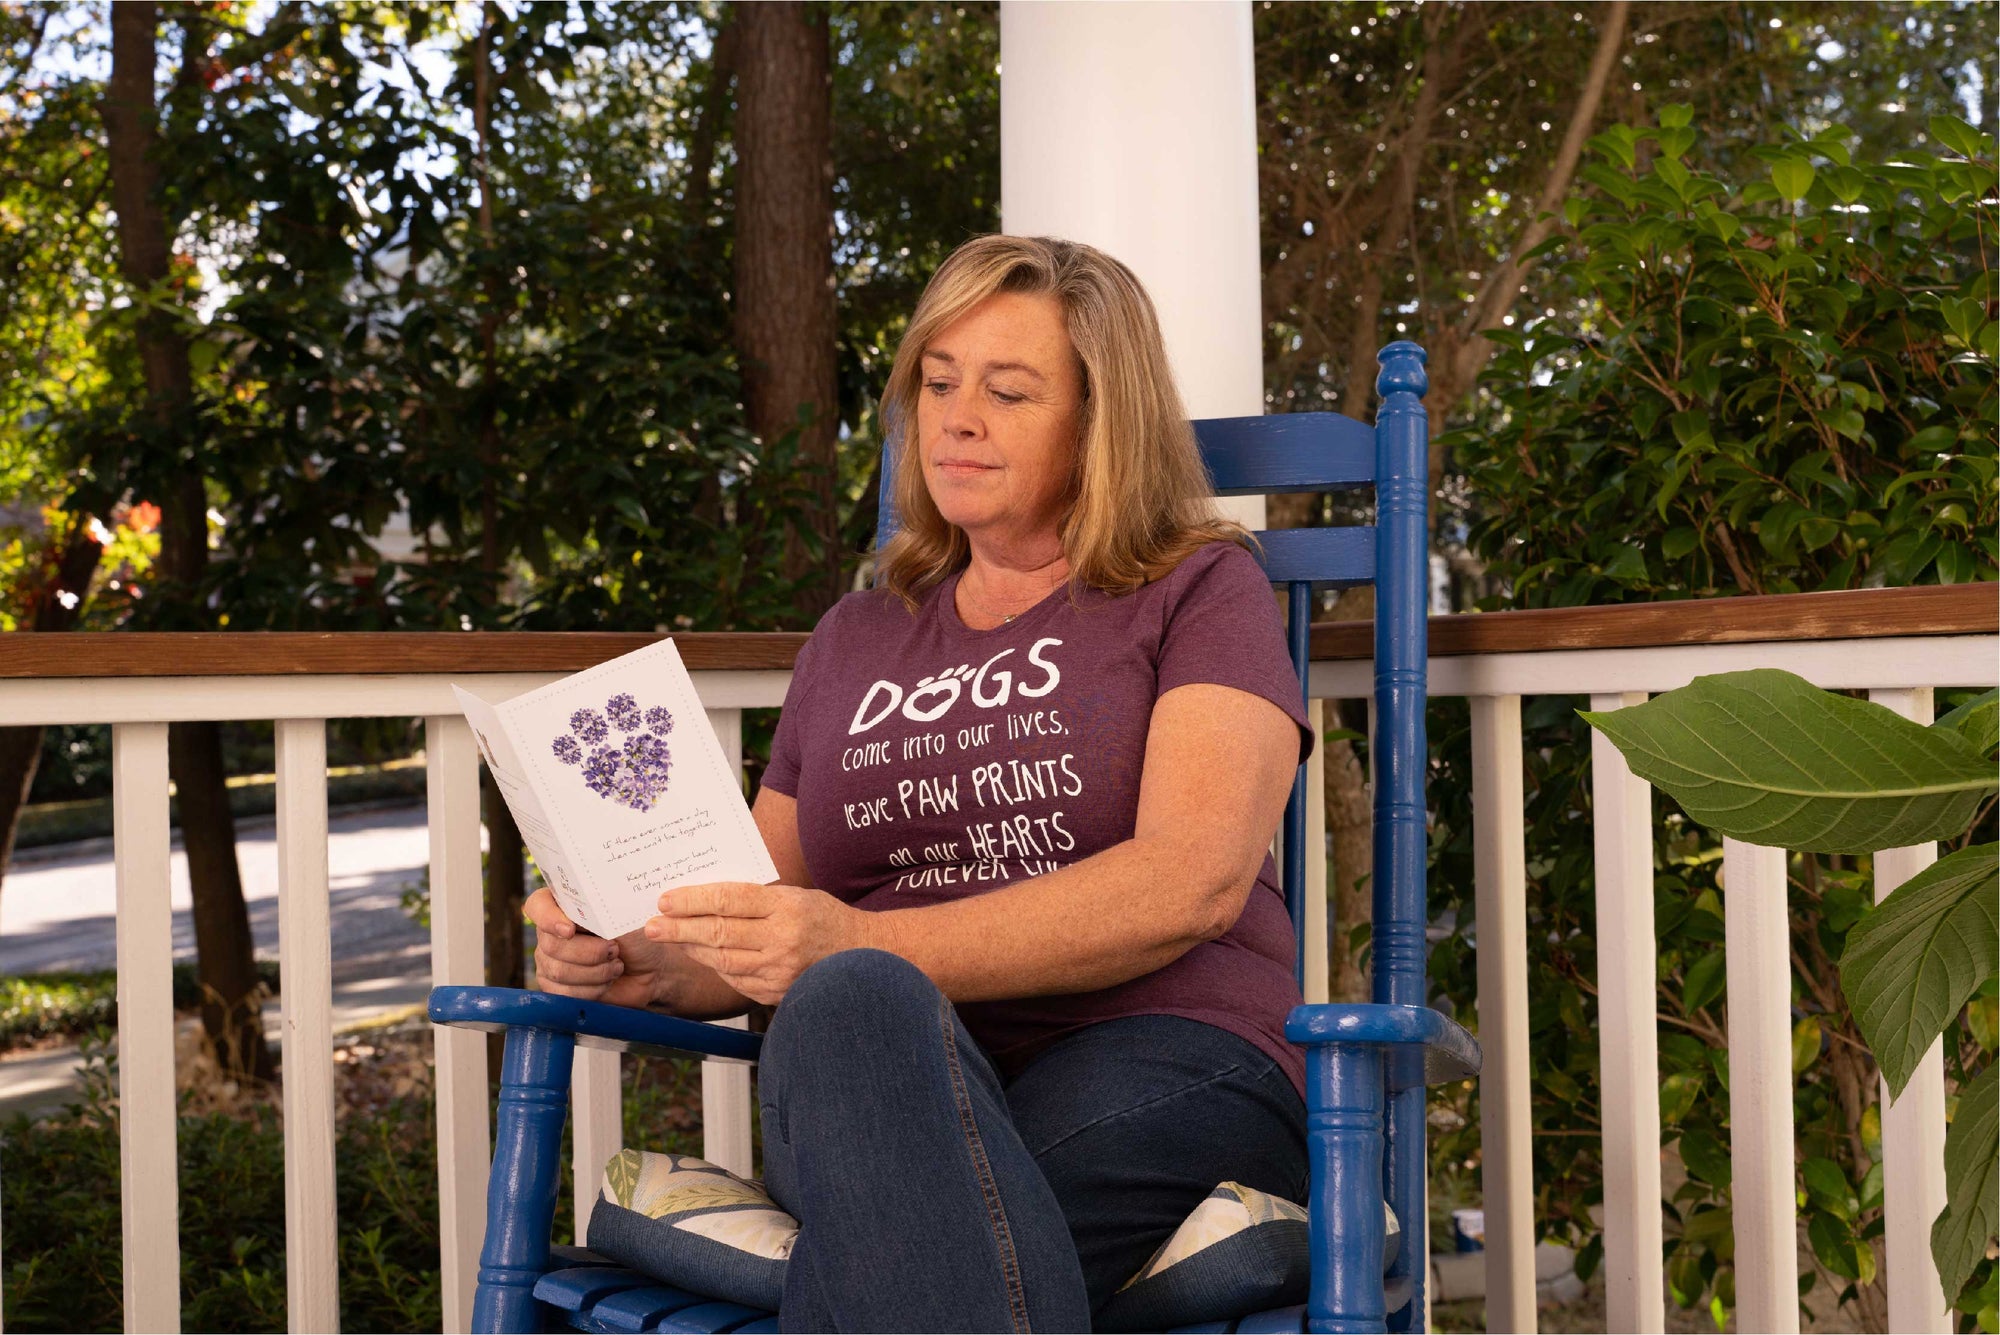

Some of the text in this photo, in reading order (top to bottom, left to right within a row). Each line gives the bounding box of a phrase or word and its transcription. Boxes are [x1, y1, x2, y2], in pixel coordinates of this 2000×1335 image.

[848, 638, 1063, 735] DOGS
[842, 710, 1070, 772] come into our lives,
[844, 753, 1082, 831] leave PAW PRINTS
[607, 852, 628, 863] when
[629, 847, 641, 855] we
[664, 833, 677, 841] be
[615, 837, 637, 845] there
[640, 828, 656, 837] ever
[694, 807, 709, 818] day
[889, 811, 1075, 868] on our HEARTS
[627, 872, 647, 881] Keep
[673, 856, 690, 869] your
[644, 880, 661, 889] stay
[663, 873, 684, 882] there
